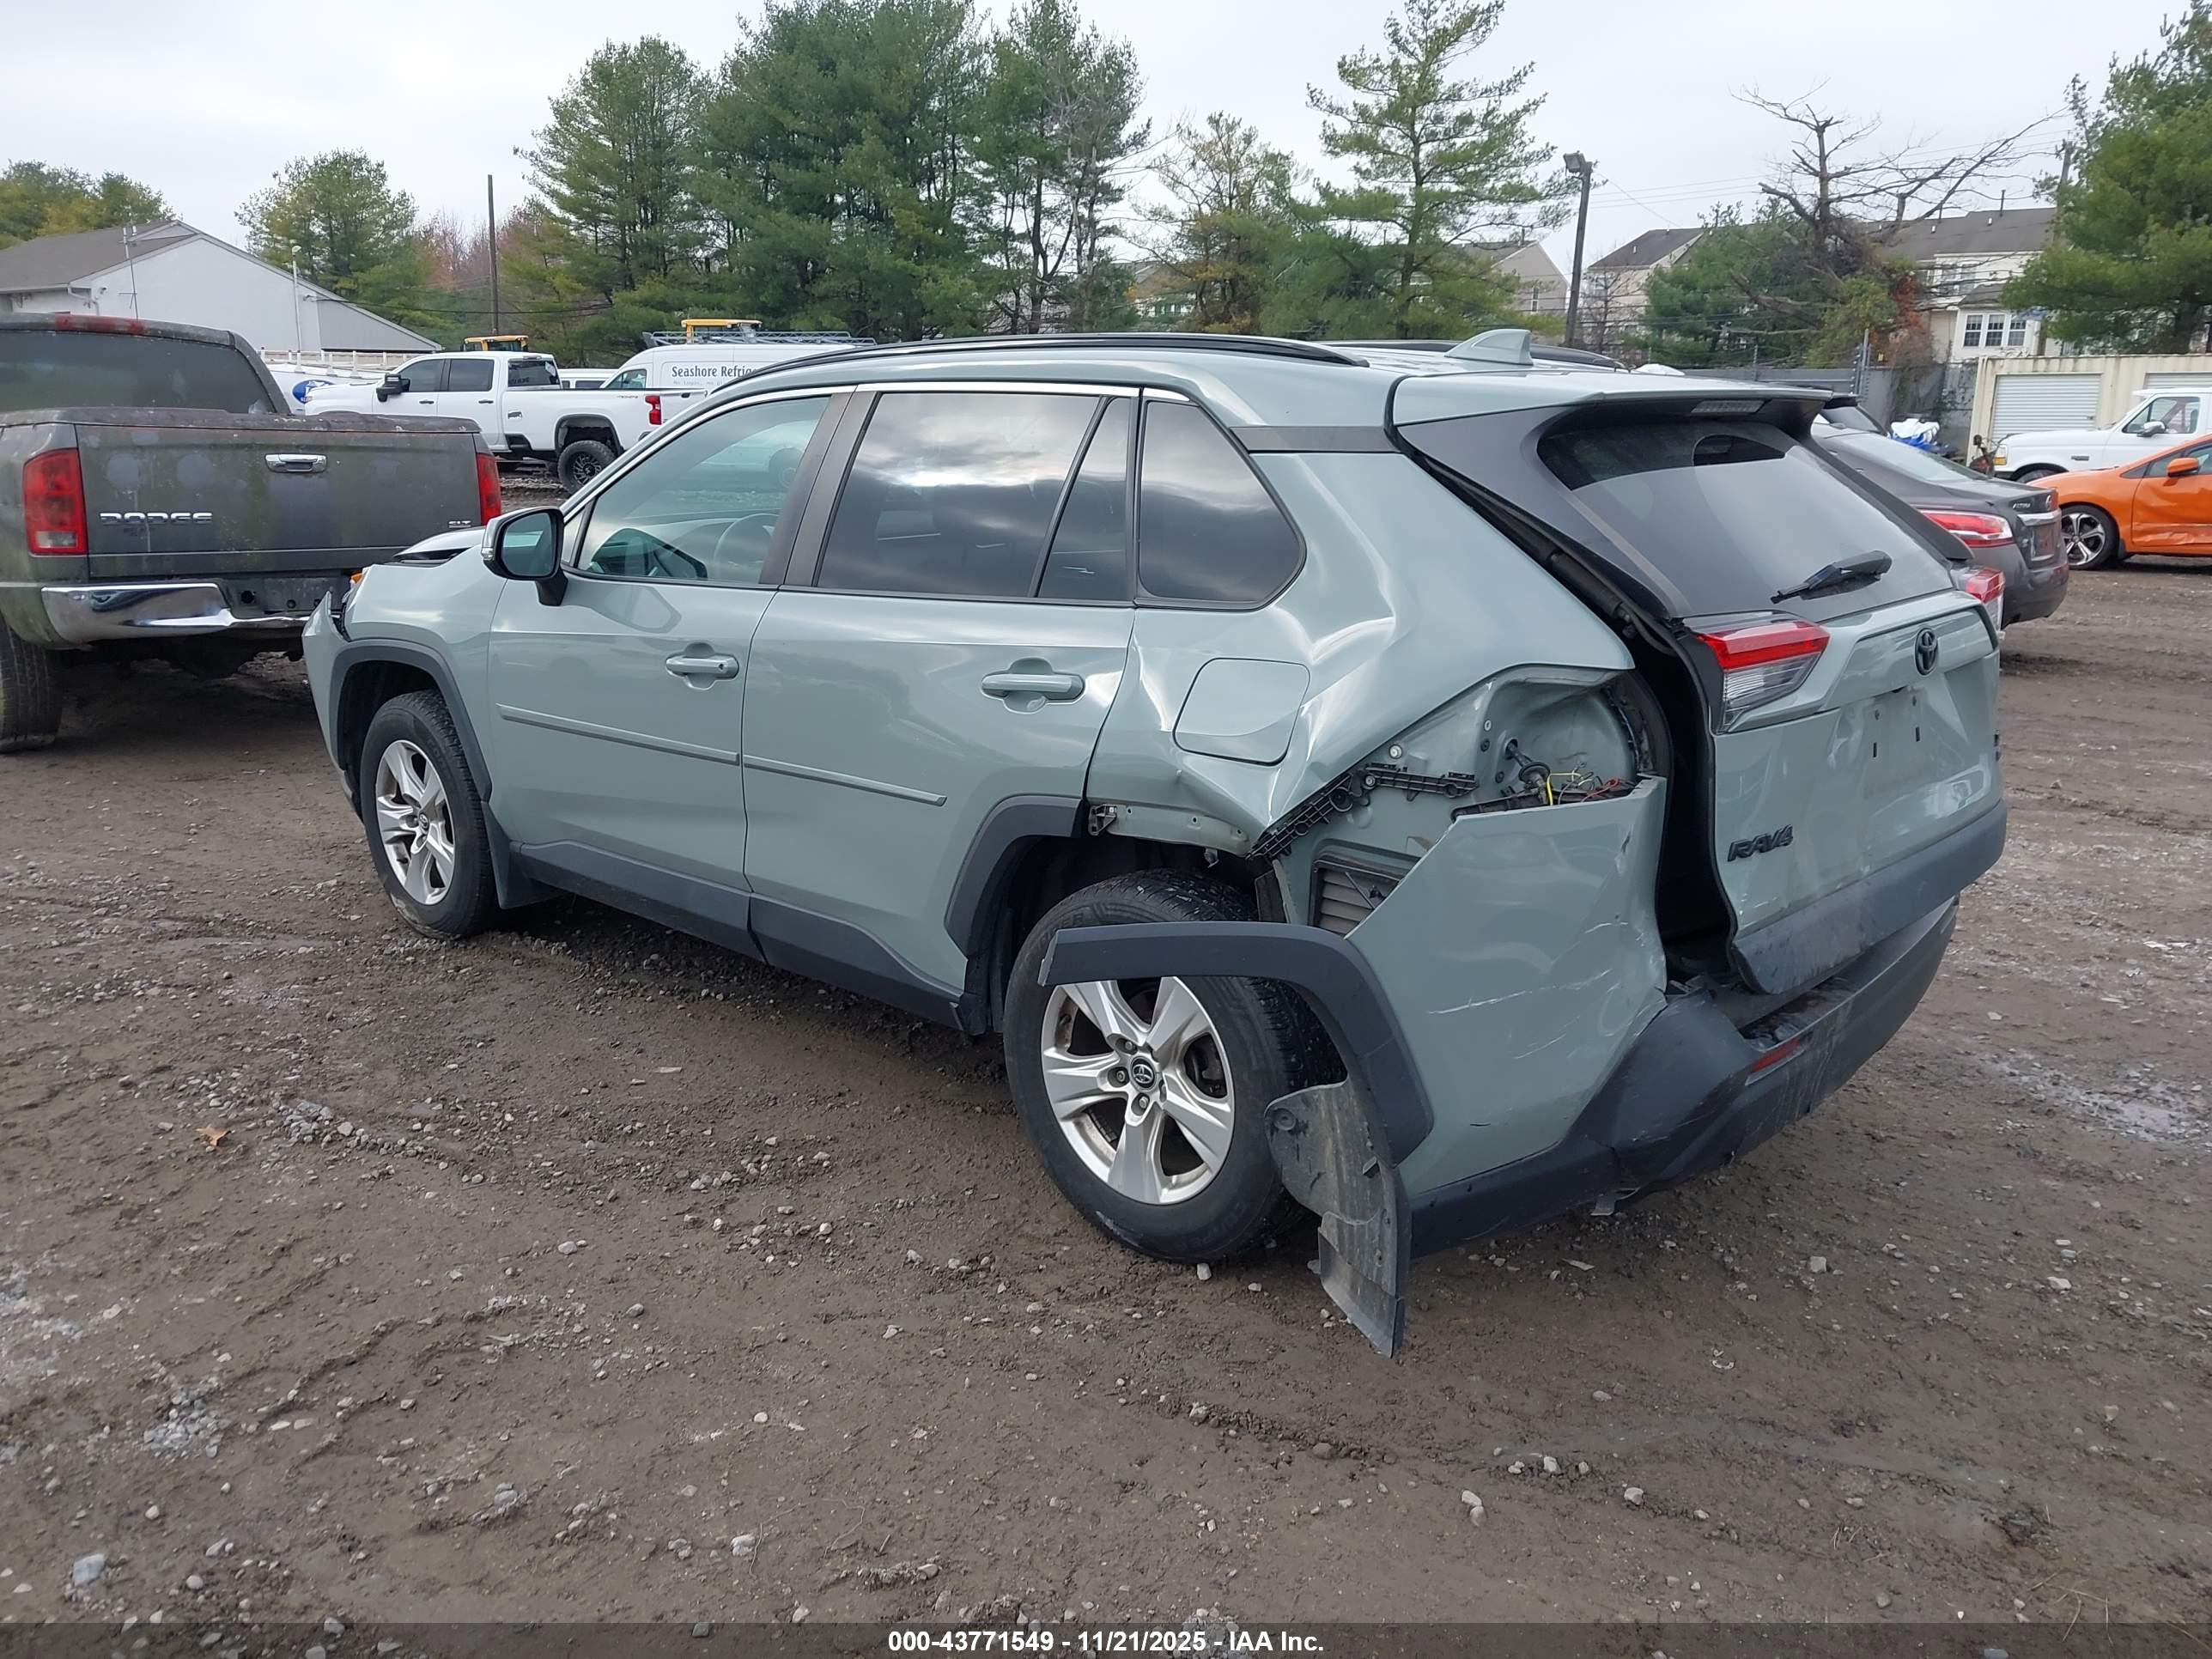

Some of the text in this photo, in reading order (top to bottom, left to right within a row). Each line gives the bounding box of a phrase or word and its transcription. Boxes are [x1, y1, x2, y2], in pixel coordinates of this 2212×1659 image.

[672, 365, 718, 378] Seashore
[99, 512, 213, 525] DODGE
[1727, 823, 1794, 862] RAV4
